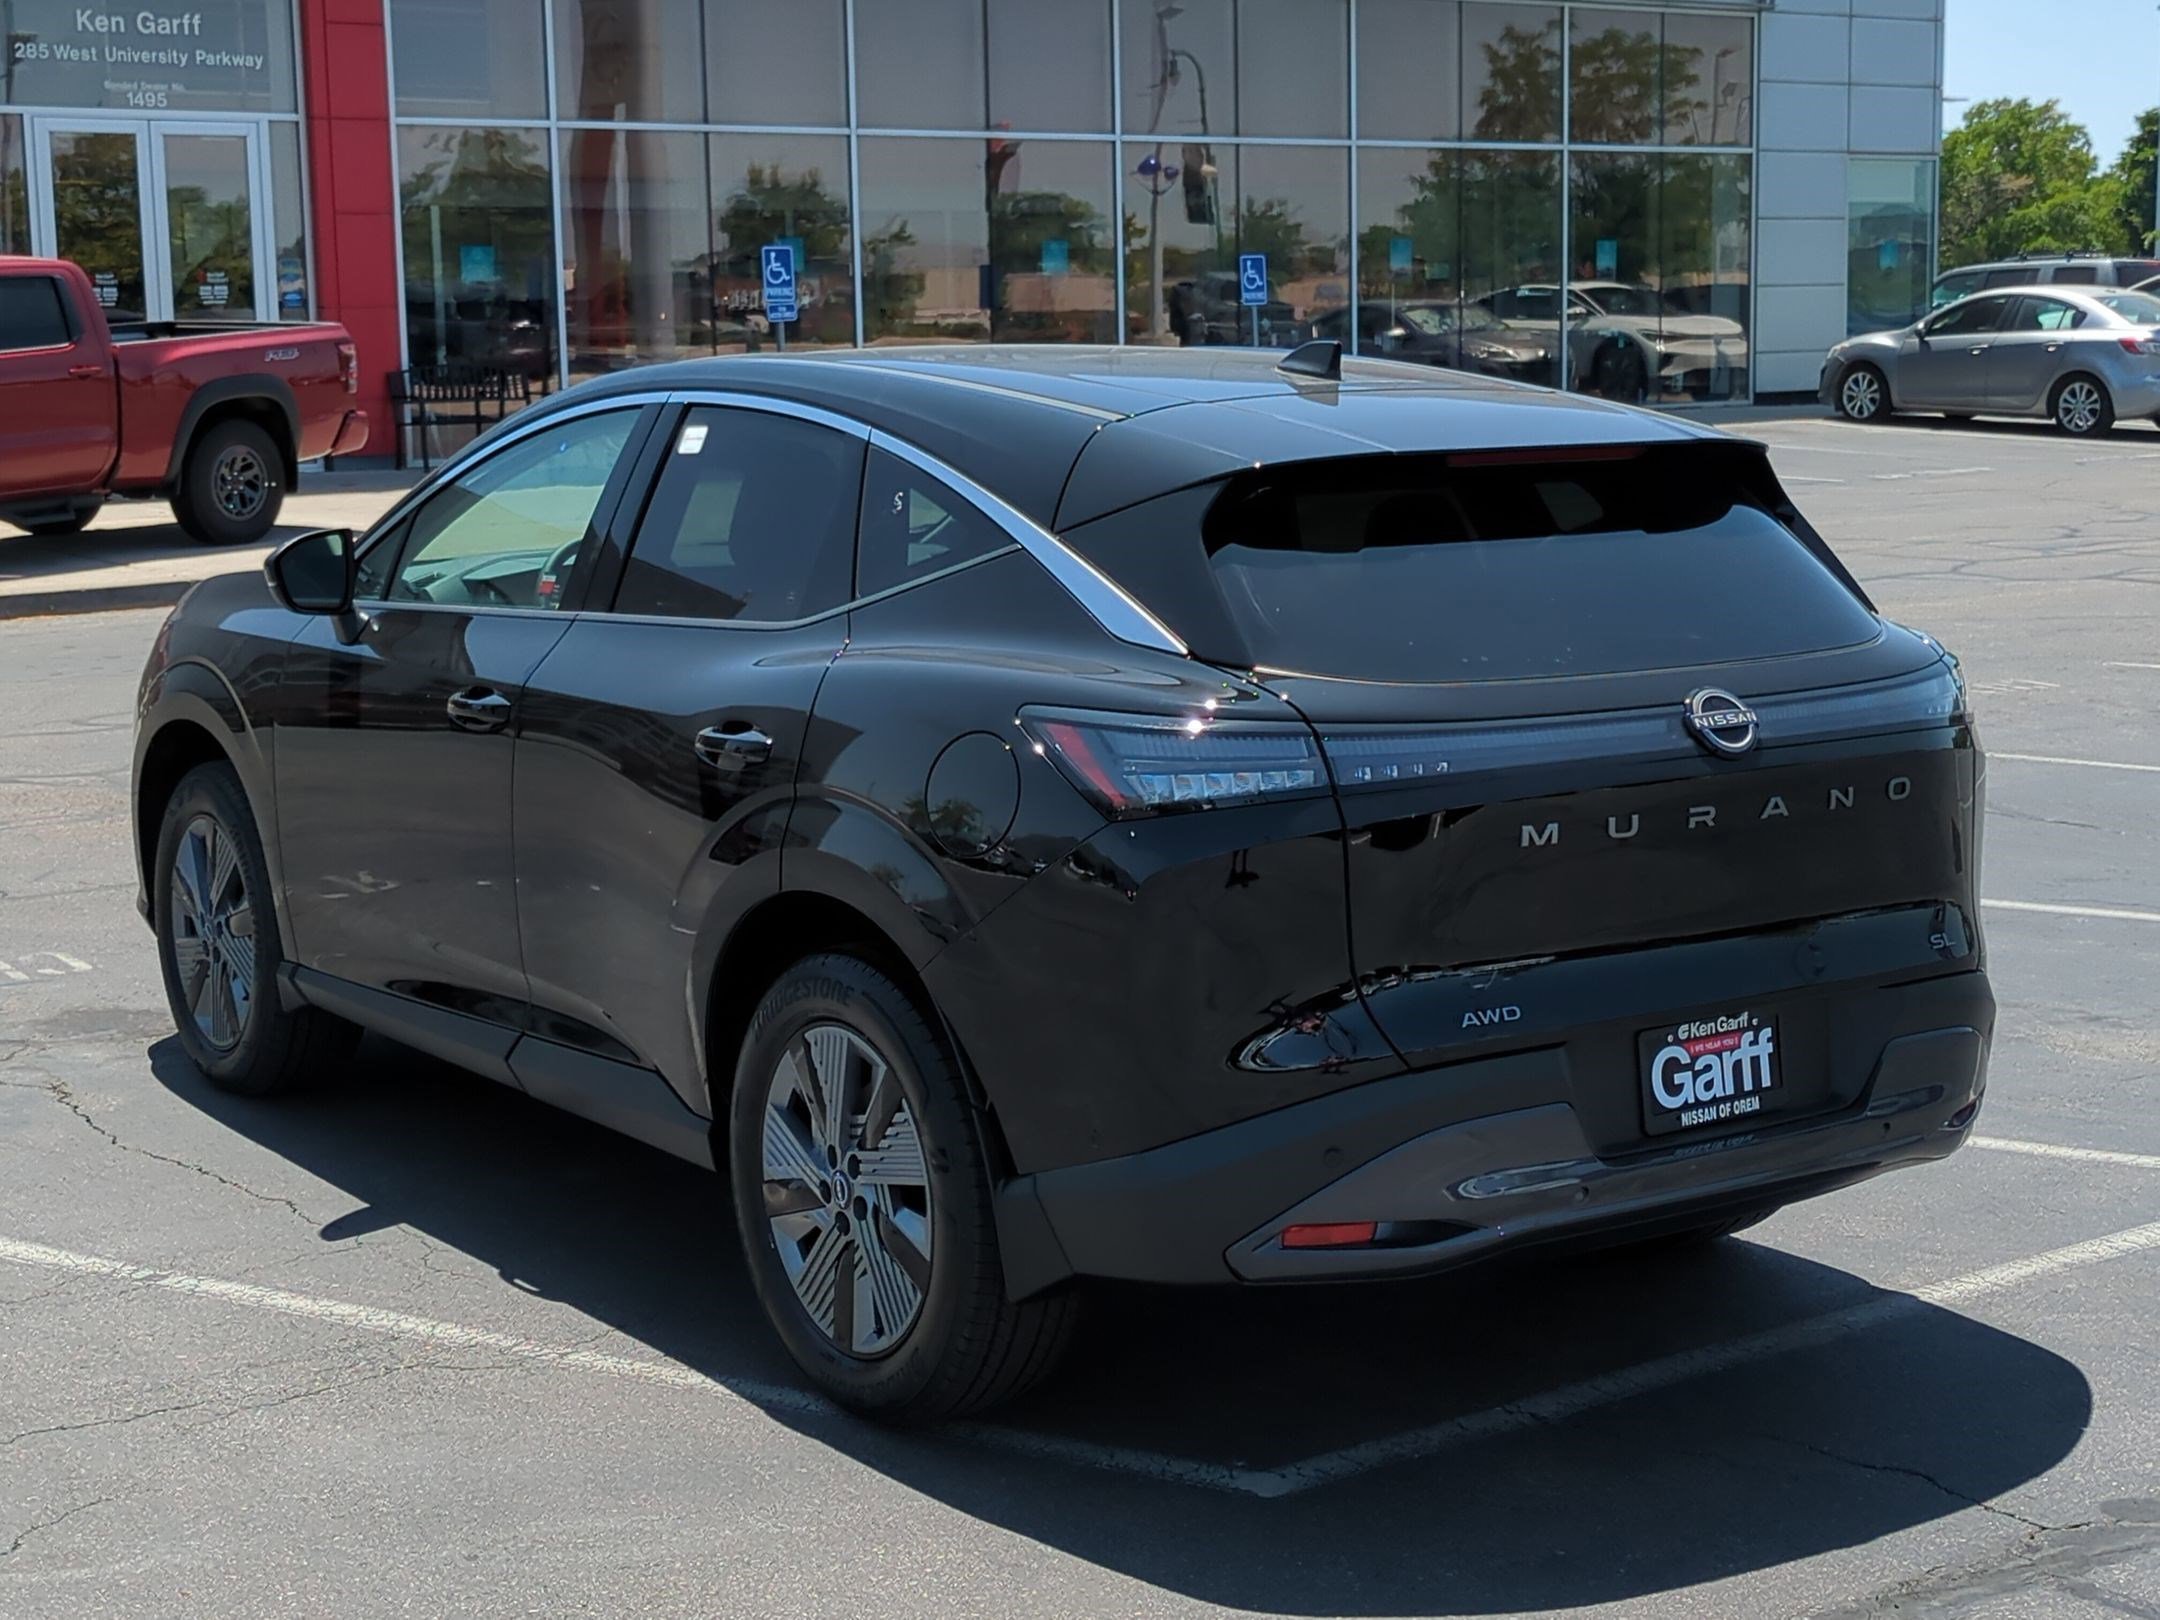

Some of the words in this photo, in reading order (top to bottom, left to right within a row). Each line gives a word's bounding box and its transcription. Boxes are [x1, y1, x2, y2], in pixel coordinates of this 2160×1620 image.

[76, 8, 125, 33] Ken
[136, 11, 201, 36] Garff
[14, 42, 49, 59] 285
[53, 44, 97, 61] West
[104, 46, 188, 68] University
[195, 49, 263, 70] Parkway
[126, 91, 167, 107] 1495
[1694, 711, 1757, 728] NISSAN
[1520, 776, 1911, 847] MURANO
[1930, 932, 1957, 949] SL
[1461, 1006, 1521, 1028] AWD
[1690, 1020, 1716, 1039] Ken
[1717, 1011, 1749, 1033] Garff
[1651, 1027, 1774, 1110] Garff
[1681, 1105, 1718, 1127] NISSAN
[1719, 1102, 1732, 1118] OF
[1733, 1095, 1761, 1115] OREM
